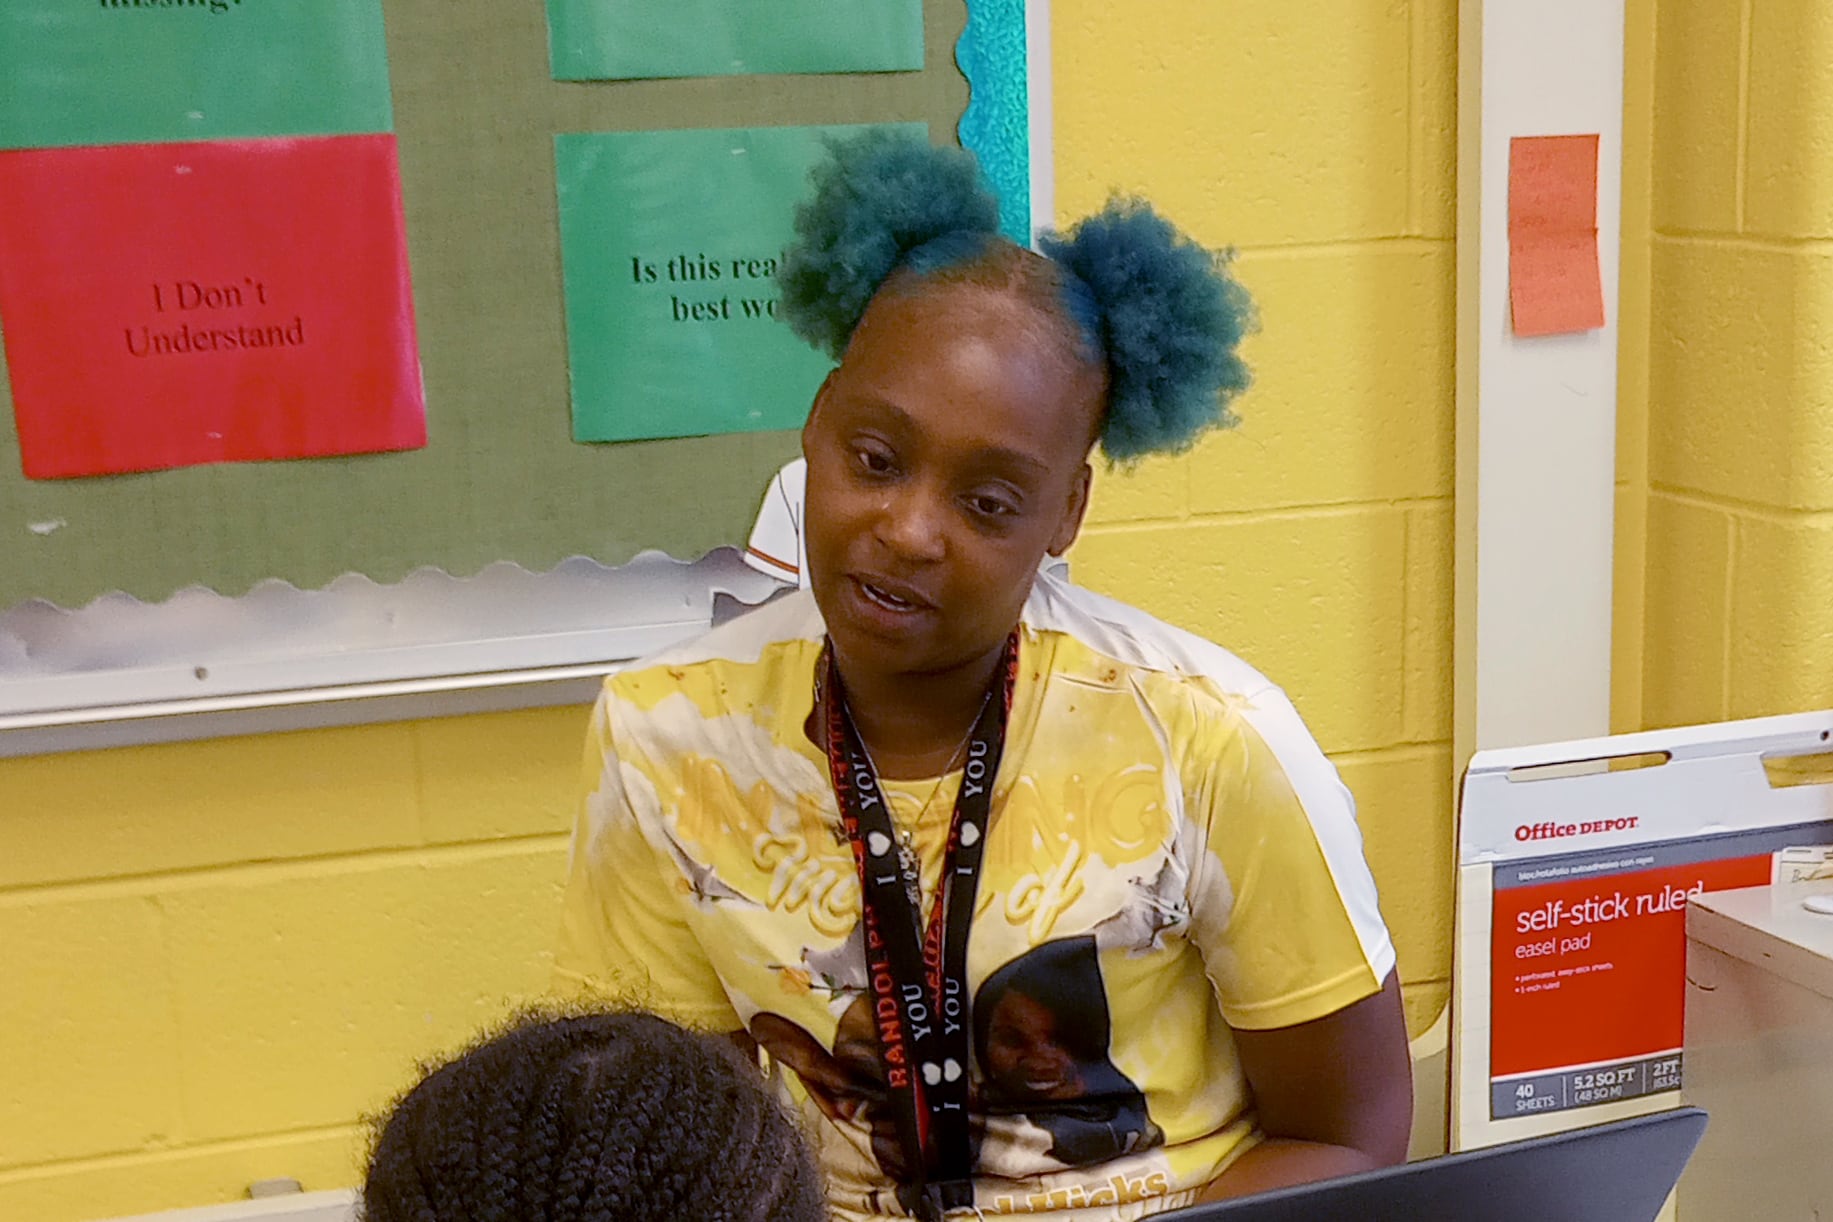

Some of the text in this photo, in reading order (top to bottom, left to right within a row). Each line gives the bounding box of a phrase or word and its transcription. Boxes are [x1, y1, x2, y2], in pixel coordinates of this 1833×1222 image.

[632, 256, 658, 284] Is
[668, 253, 721, 283] this
[153, 277, 266, 312] I Don't
[671, 295, 730, 322] best
[125, 317, 304, 358] Understand
[965, 740, 987, 798] YOU
[1515, 816, 1639, 842] Office DEPOT
[1005, 838, 1085, 945] of
[1516, 880, 1704, 933] self-stick ruled
[1515, 932, 1591, 959] easel pad
[902, 983, 932, 1042] YOU
[945, 977, 961, 1035] YOU
[1516, 1084, 1534, 1098] 40
[1574, 1067, 1635, 1090] 5.2 SQ FT
[1516, 1095, 1556, 1112] SHEETS
